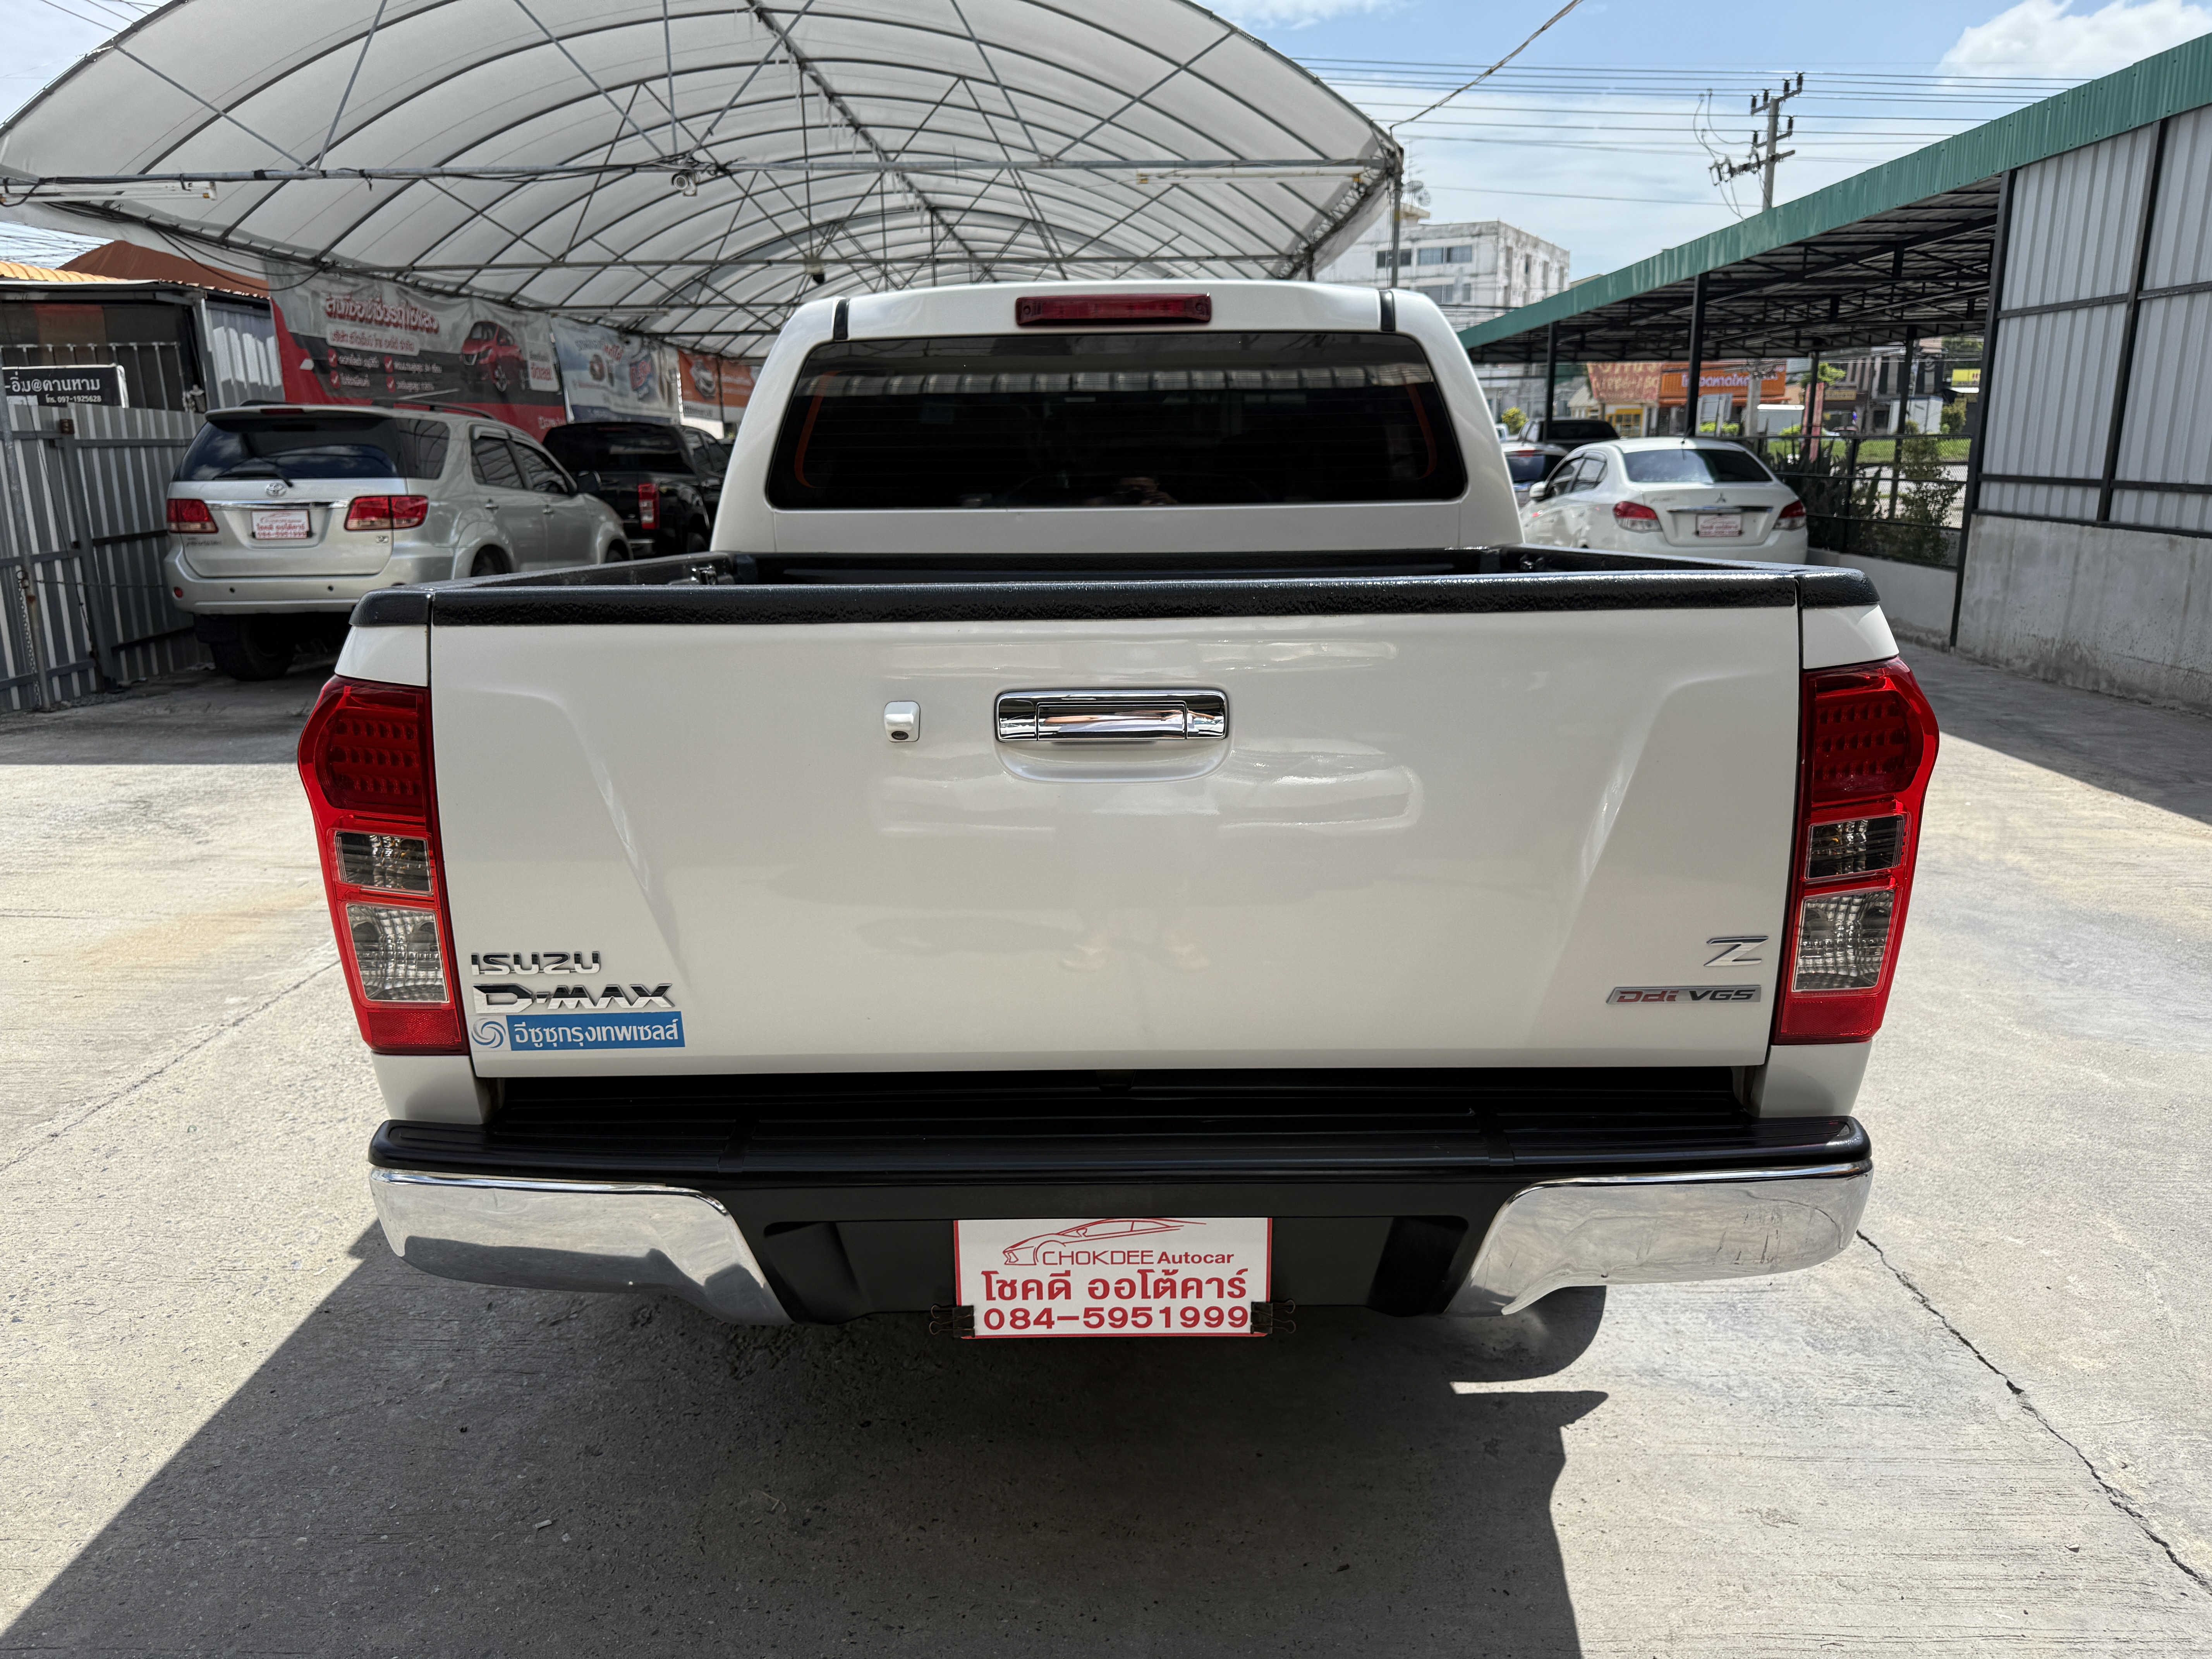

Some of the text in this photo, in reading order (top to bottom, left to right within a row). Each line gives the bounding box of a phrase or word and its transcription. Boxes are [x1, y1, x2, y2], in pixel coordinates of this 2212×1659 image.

[471, 951, 601, 975] ISUZU
[1704, 936, 1769, 966] Z
[472, 983, 675, 1013] D-MAX
[1616, 989, 1756, 1002] Ddi VGS
[514, 1018, 679, 1048] อีซูซุกรุงเทพเซลส์
[1042, 1250, 1234, 1265] CHOKDEE Autocar
[981, 1268, 1248, 1301] โชคดี ออโต้คาร์
[984, 1305, 1249, 1330] 084-5951999
